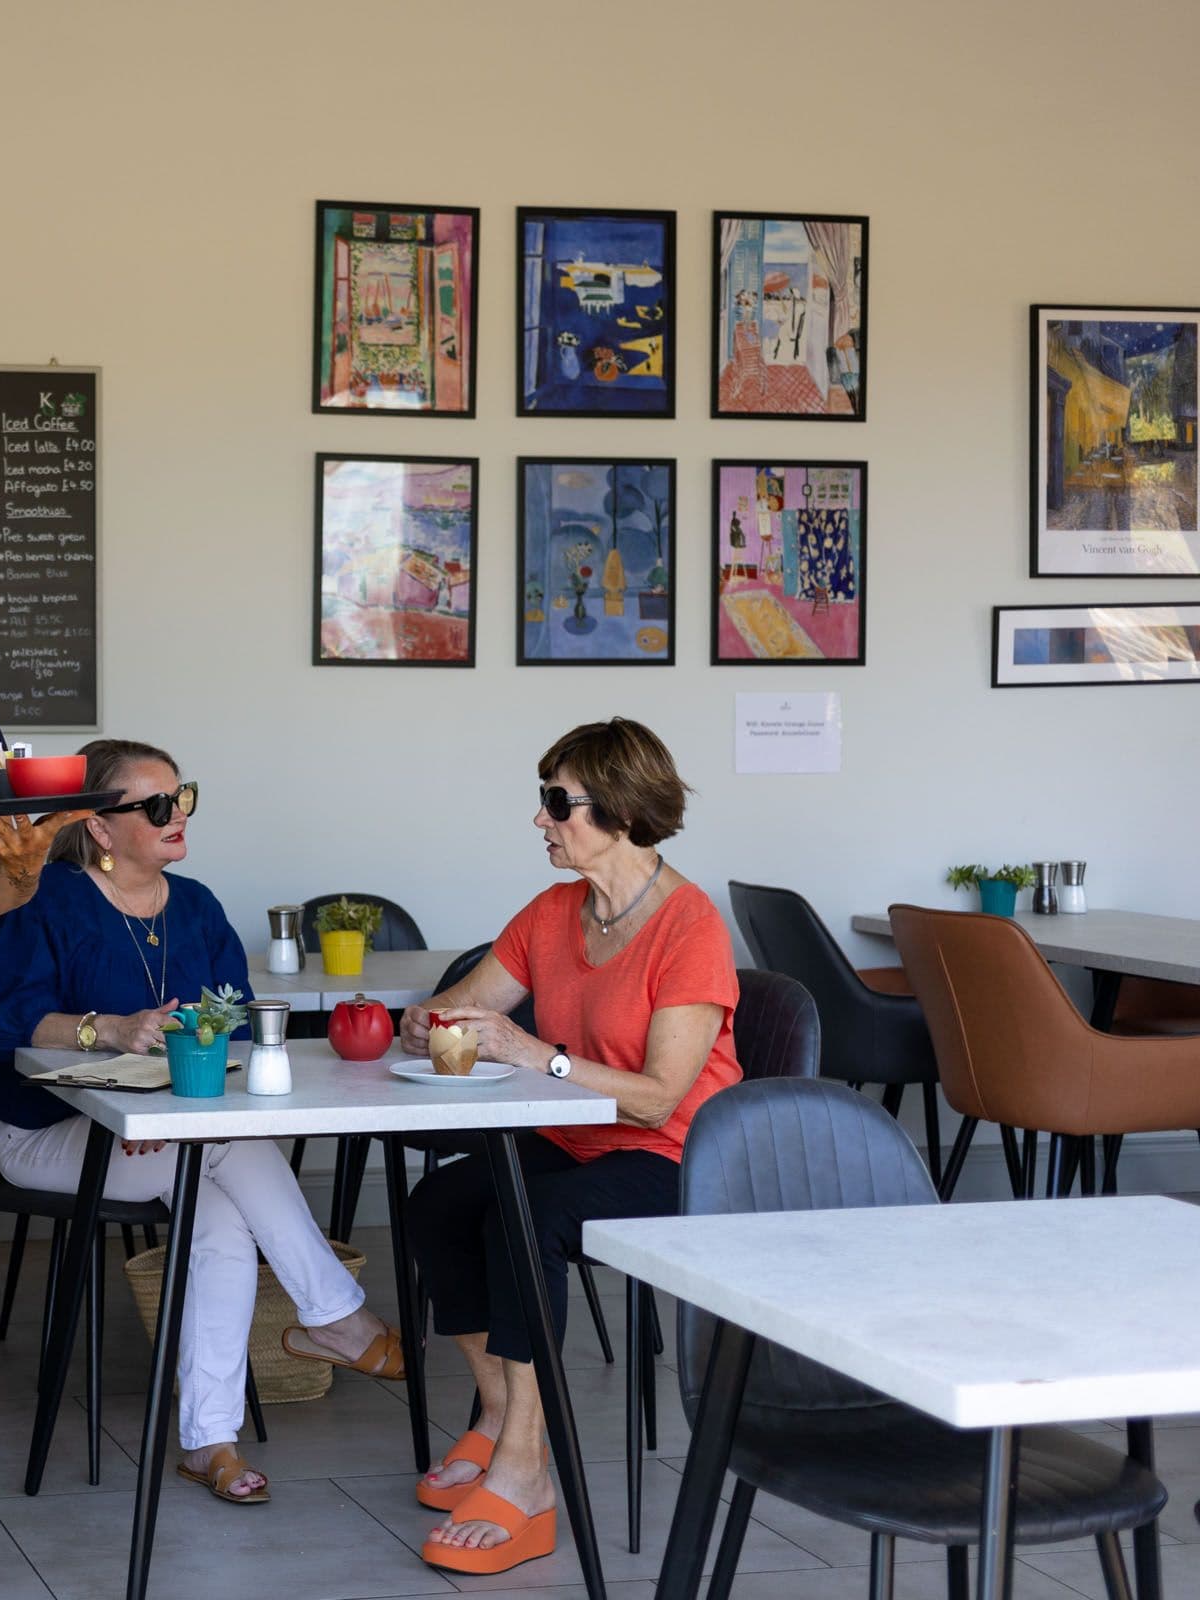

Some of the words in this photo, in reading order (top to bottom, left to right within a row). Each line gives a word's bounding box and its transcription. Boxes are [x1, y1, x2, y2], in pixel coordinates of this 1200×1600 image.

[1, 413, 30, 432] Iced
[34, 414, 79, 432] Coffee
[3, 436, 31, 454] Iced
[1081, 543, 1117, 555] Vincent
[1118, 546, 1135, 555] van
